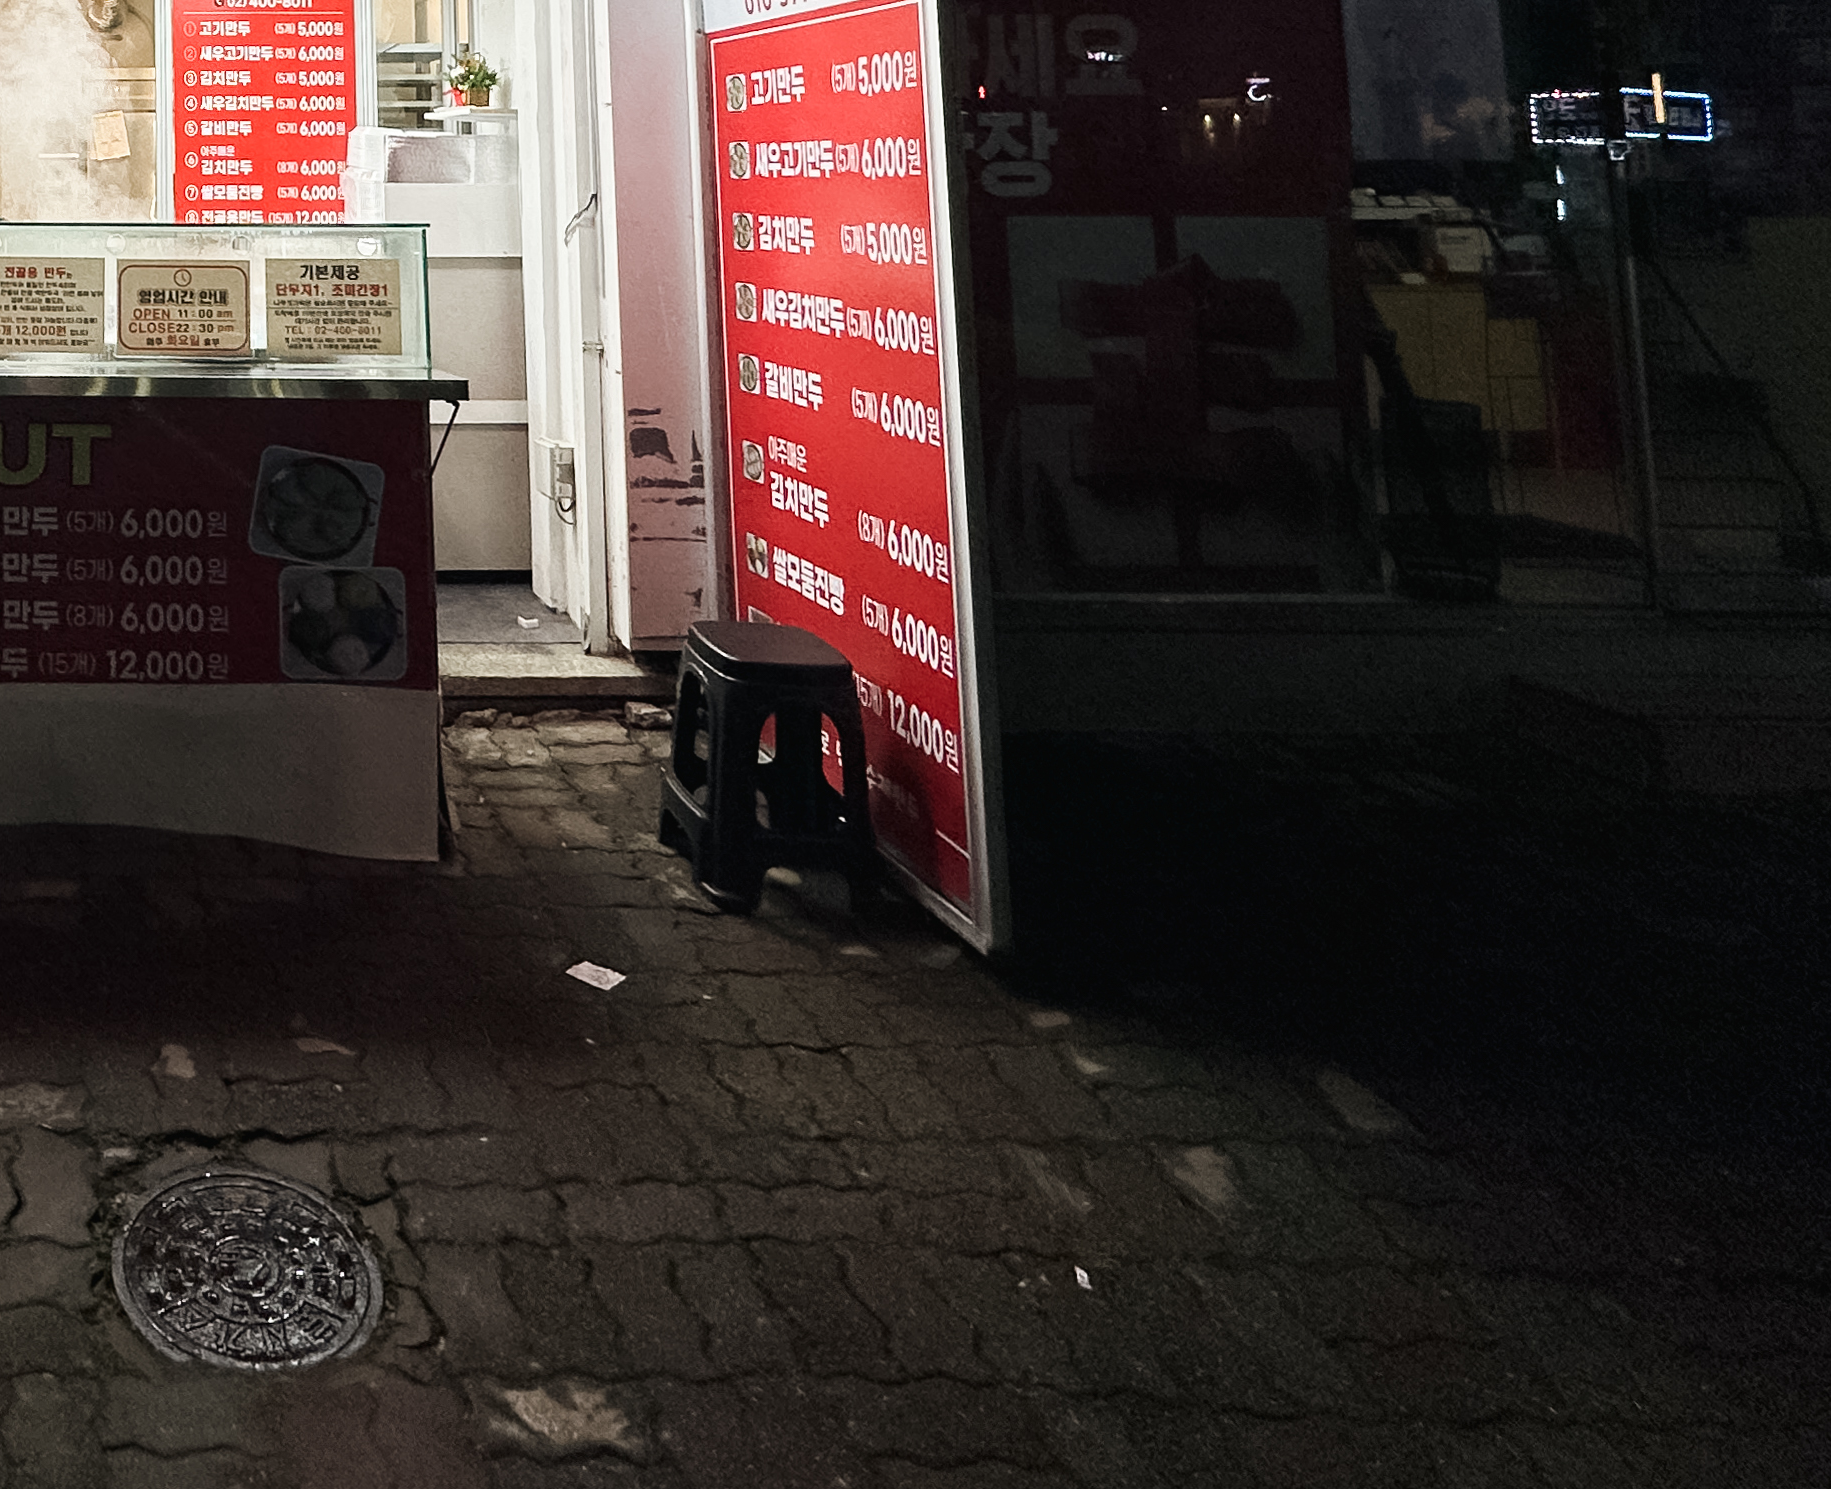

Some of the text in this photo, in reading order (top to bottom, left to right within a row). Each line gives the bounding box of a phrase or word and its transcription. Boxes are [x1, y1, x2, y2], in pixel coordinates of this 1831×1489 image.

[199, 21, 251, 36] 고기만두
[298, 21, 344, 36] 5,000원
[200, 46, 274, 61] 새우고기만두
[298, 46, 344, 61] 6,000원
[200, 70, 251, 86] 김치만두
[299, 70, 345, 86] 5,000원
[751, 50, 917, 105] 고기만두 (5개) 5,000원
[200, 95, 274, 111] 새우김치만두
[299, 95, 346, 111] 6,000원
[200, 120, 252, 136] 갈비만두
[299, 120, 346, 136] 6,000원
[201, 160, 253, 176] 김치만두
[755, 136, 922, 180] 새우고기만두 (5개) 6,000원
[758, 214, 928, 265] 김치만두 (5개) 5,000원
[300, 265, 360, 280] 기본제공
[139, 290, 227, 305] 영업시간 안내
[133, 308, 171, 320] OPEN
[216, 310, 233, 318] am
[762, 288, 935, 355] 새우김치만두 (5개) 6,000원
[16, 325, 67, 337] 12,000원
[167, 335, 200, 346] 화요일
[218, 324, 234, 334] pm
[285, 326, 304, 335] TEL
[765, 361, 942, 447] 갈비만두 (5개) 6,000원
[767, 436, 808, 473] 아주매운
[66, 510, 114, 535] (5개)
[119, 508, 227, 540] 6,000원
[770, 471, 950, 584] 김치만두 (8개) 6,000원
[66, 558, 114, 583] (5개)
[119, 555, 228, 587] 6,000원
[66, 604, 114, 630] (8개)
[119, 602, 228, 635] 6,000원
[773, 545, 954, 679] 쌀모둠진빵 (5개) 6,000원
[37, 650, 97, 677] (15개)
[106, 648, 229, 681] 12,000원
[887, 688, 960, 775] 12,000원
